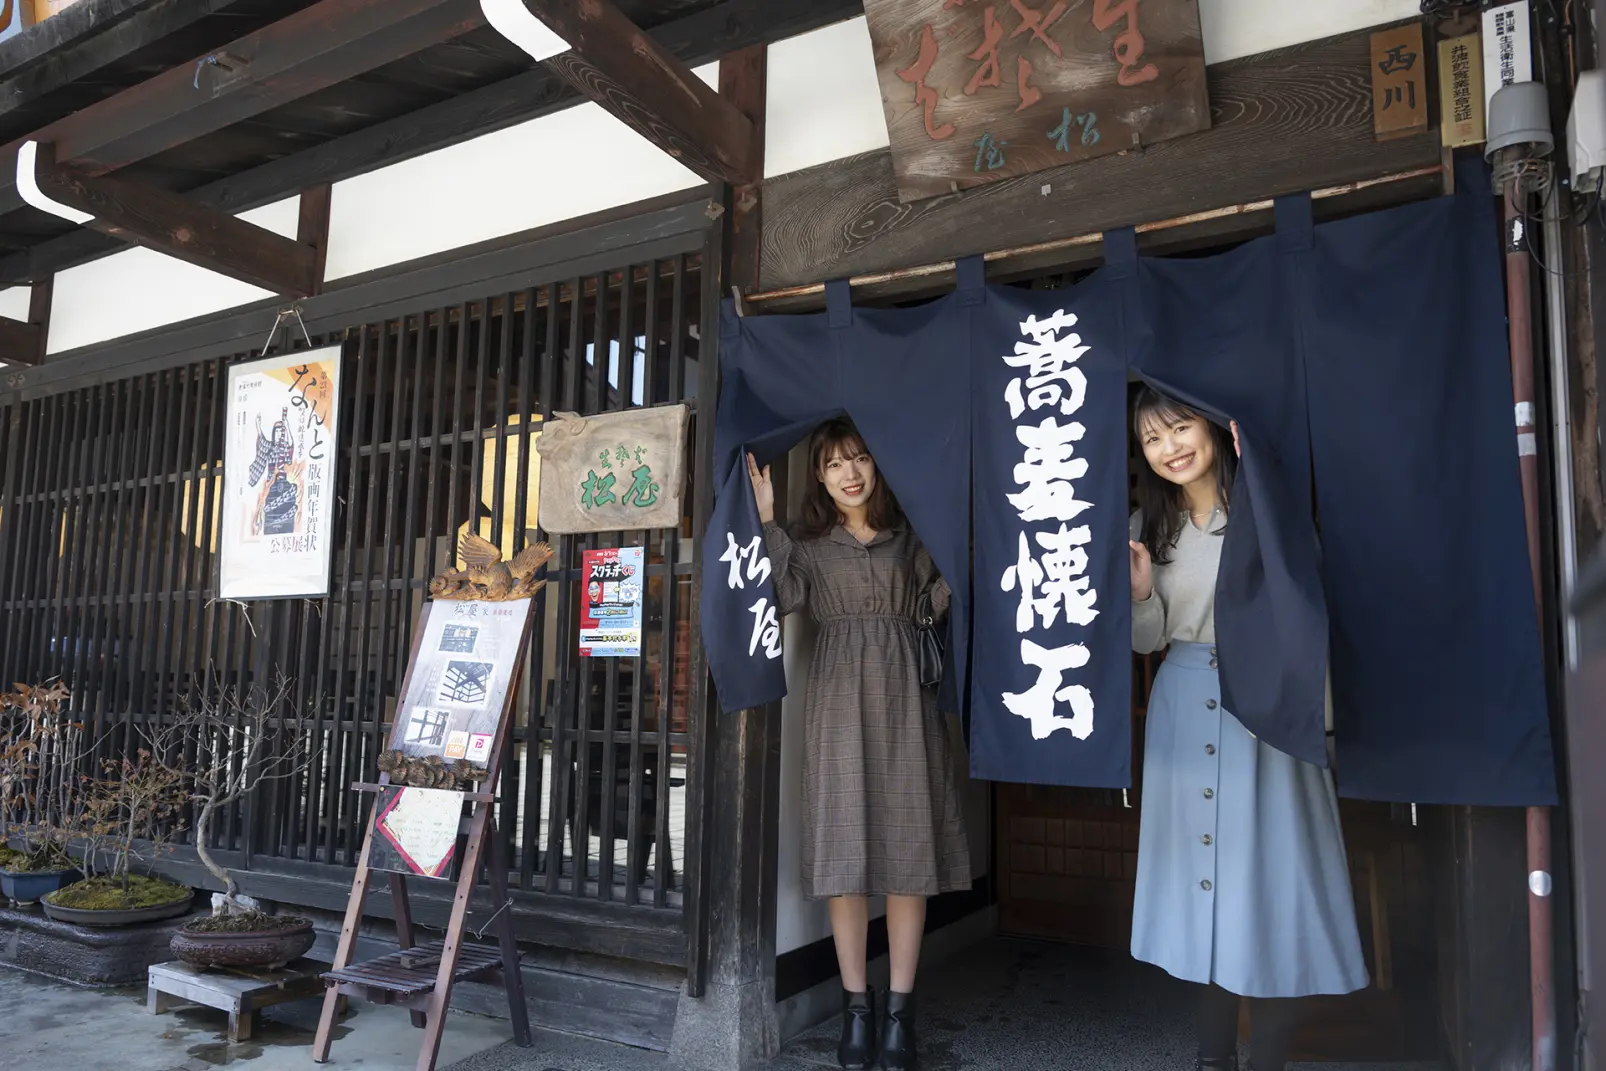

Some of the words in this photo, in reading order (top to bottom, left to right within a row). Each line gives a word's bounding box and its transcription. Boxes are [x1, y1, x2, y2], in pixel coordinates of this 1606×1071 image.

[1378, 44, 1417, 111] 西川
[303, 463, 321, 552] 版画年賀状
[581, 464, 660, 510] 松屋
[1000, 309, 1100, 740] 蕎麦懐石
[590, 564, 636, 578] スクラッチくじ
[718, 532, 782, 659] 松屋
